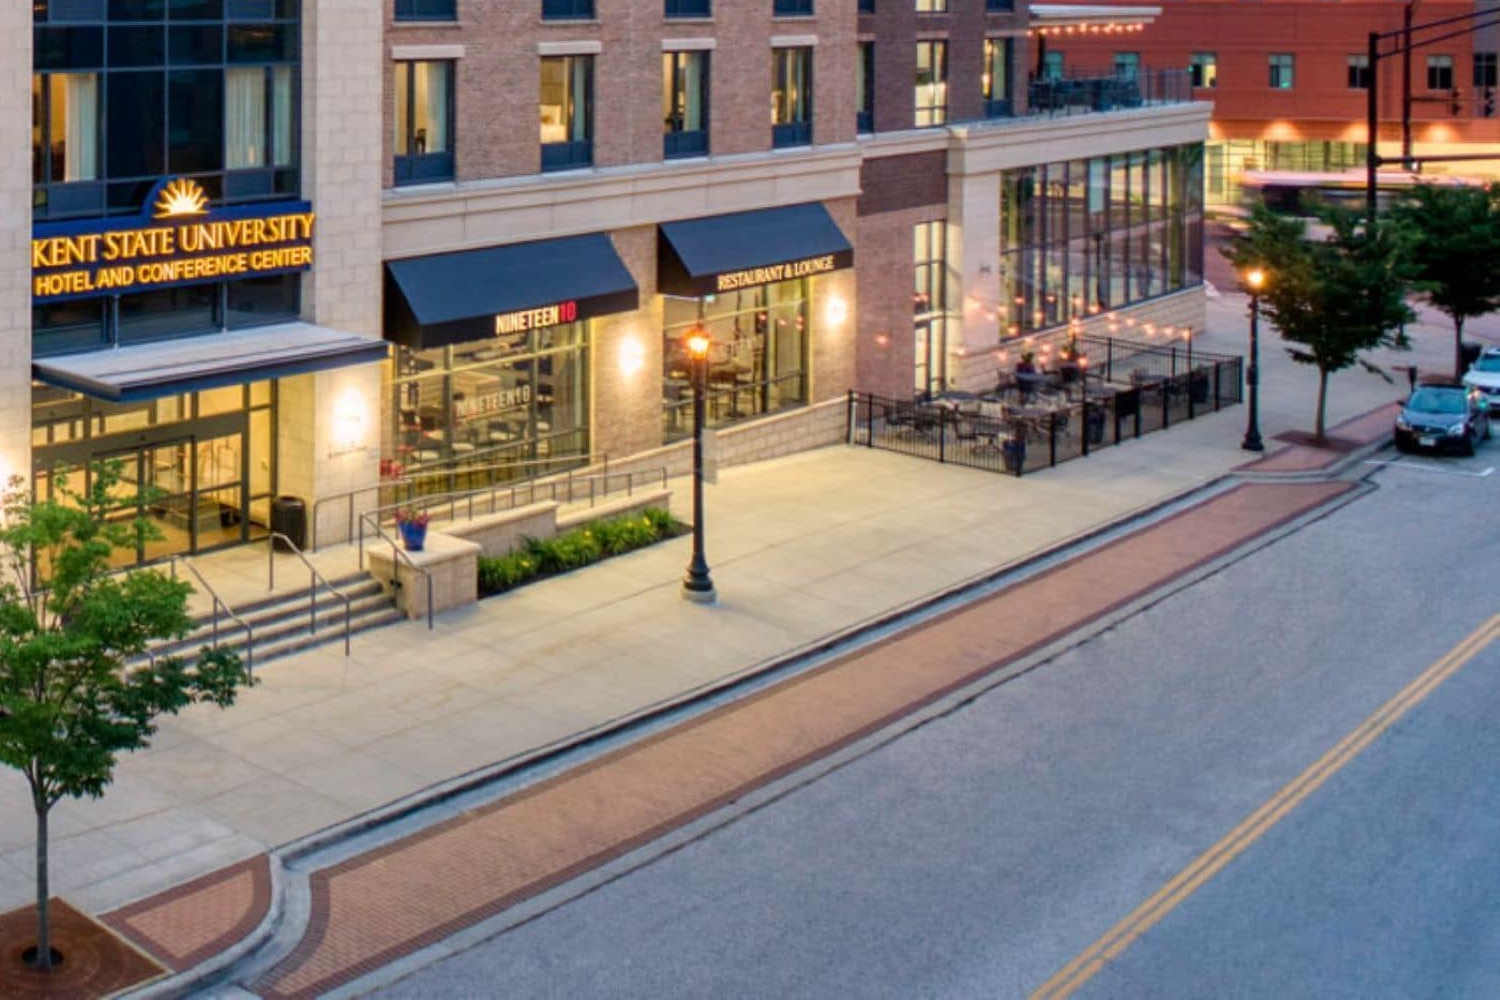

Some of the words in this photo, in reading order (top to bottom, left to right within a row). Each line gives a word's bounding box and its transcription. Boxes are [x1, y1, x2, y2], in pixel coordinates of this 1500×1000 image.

[32, 235, 99, 267] KENT
[104, 227, 174, 260] STATE
[180, 213, 315, 251] UNIVERSITY
[35, 271, 94, 296] HOTEL
[98, 266, 134, 288] AND
[138, 253, 248, 282] CONFERENCE
[251, 246, 312, 270] CENTER
[717, 264, 784, 291] RESTAURANT
[784, 262, 793, 279] &
[794, 254, 835, 276] LOUNGE
